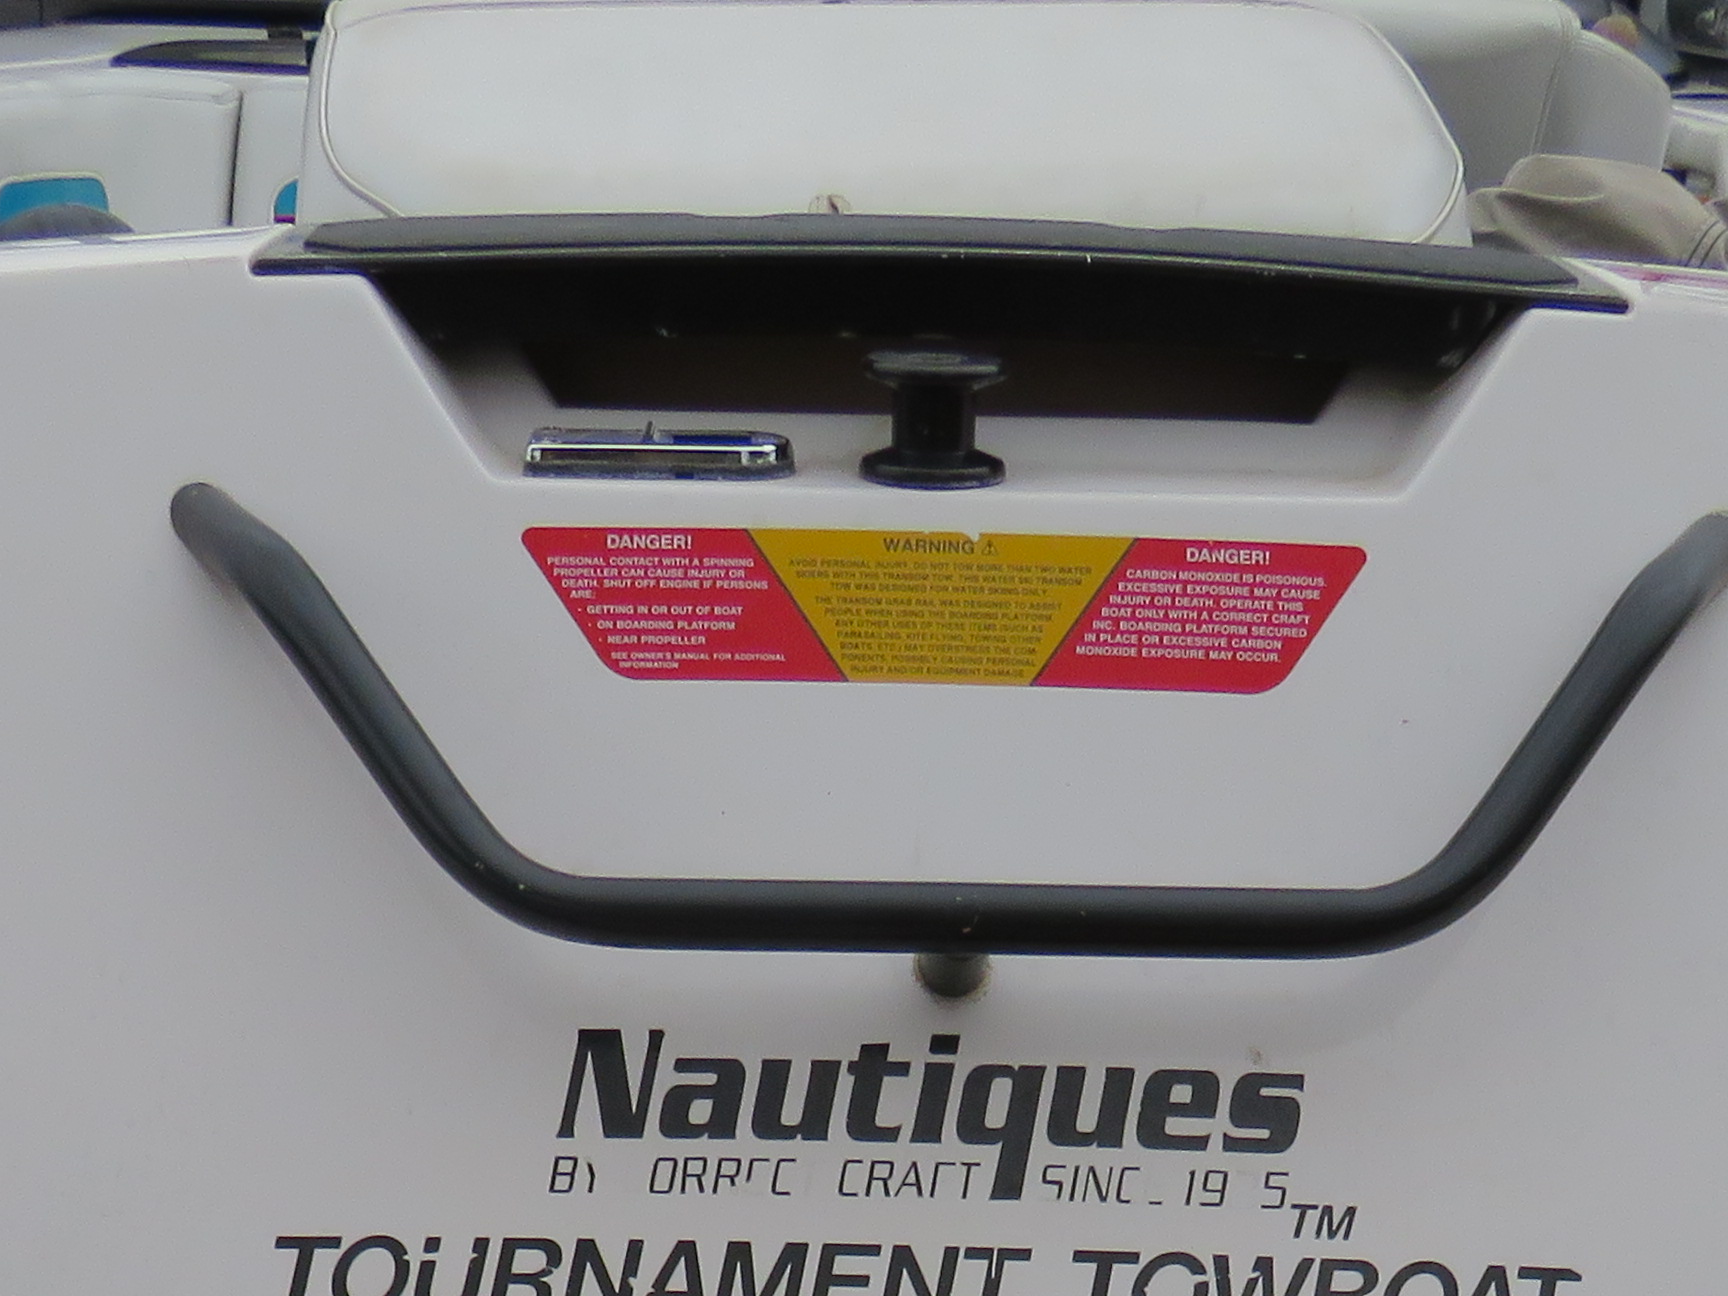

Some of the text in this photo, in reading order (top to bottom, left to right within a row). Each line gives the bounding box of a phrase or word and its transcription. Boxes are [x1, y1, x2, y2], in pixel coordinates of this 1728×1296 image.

[606, 534, 692, 550] DANGER!
[883, 538, 975, 555] WARNING
[547, 556, 754, 567] PERSONAL CONTACT WITH A SPINNING
[1185, 547, 1270, 565] DANGER!
[553, 568, 745, 578] PROPELLER CAN CAUSE INJURY OR
[1126, 569, 1327, 587] CARBON MONOXIDE IS POISONOUS.
[603, 579, 632, 589] SHUT
[634, 580, 656, 589] OFF
[659, 580, 700, 589] ENGINE
[703, 580, 714, 589] IF
[716, 580, 768, 590] PERSONS
[1118, 582, 1320, 600] EXCESSIVE EXPOSURE MAY CAUSE
[586, 605, 743, 615] GETTING IN OR OUT OF BOAT
[1109, 594, 1151, 605] INJURY
[1154, 596, 1171, 606] OR
[1220, 599, 1273, 610] OPERATE
[1277, 601, 1304, 612] THIS
[1101, 607, 1310, 625] BOAT ONLY WITH A CORRECT CRAFT
[597, 620, 736, 630] ON BOARDING PLATFORM
[1092, 620, 1308, 638] INC. BOARDING PLATFORM SECURED
[607, 635, 706, 645] NEAR PROPELLER
[1084, 633, 1282, 650] IN PLACE OR EXCESSIVE CARBON
[1075, 645, 1281, 662] MONOXIDE EXPOSURE MAY OCCUR.
[556, 1028, 1306, 1201] Nautiques
[1184, 1169, 1289, 1210] 195
